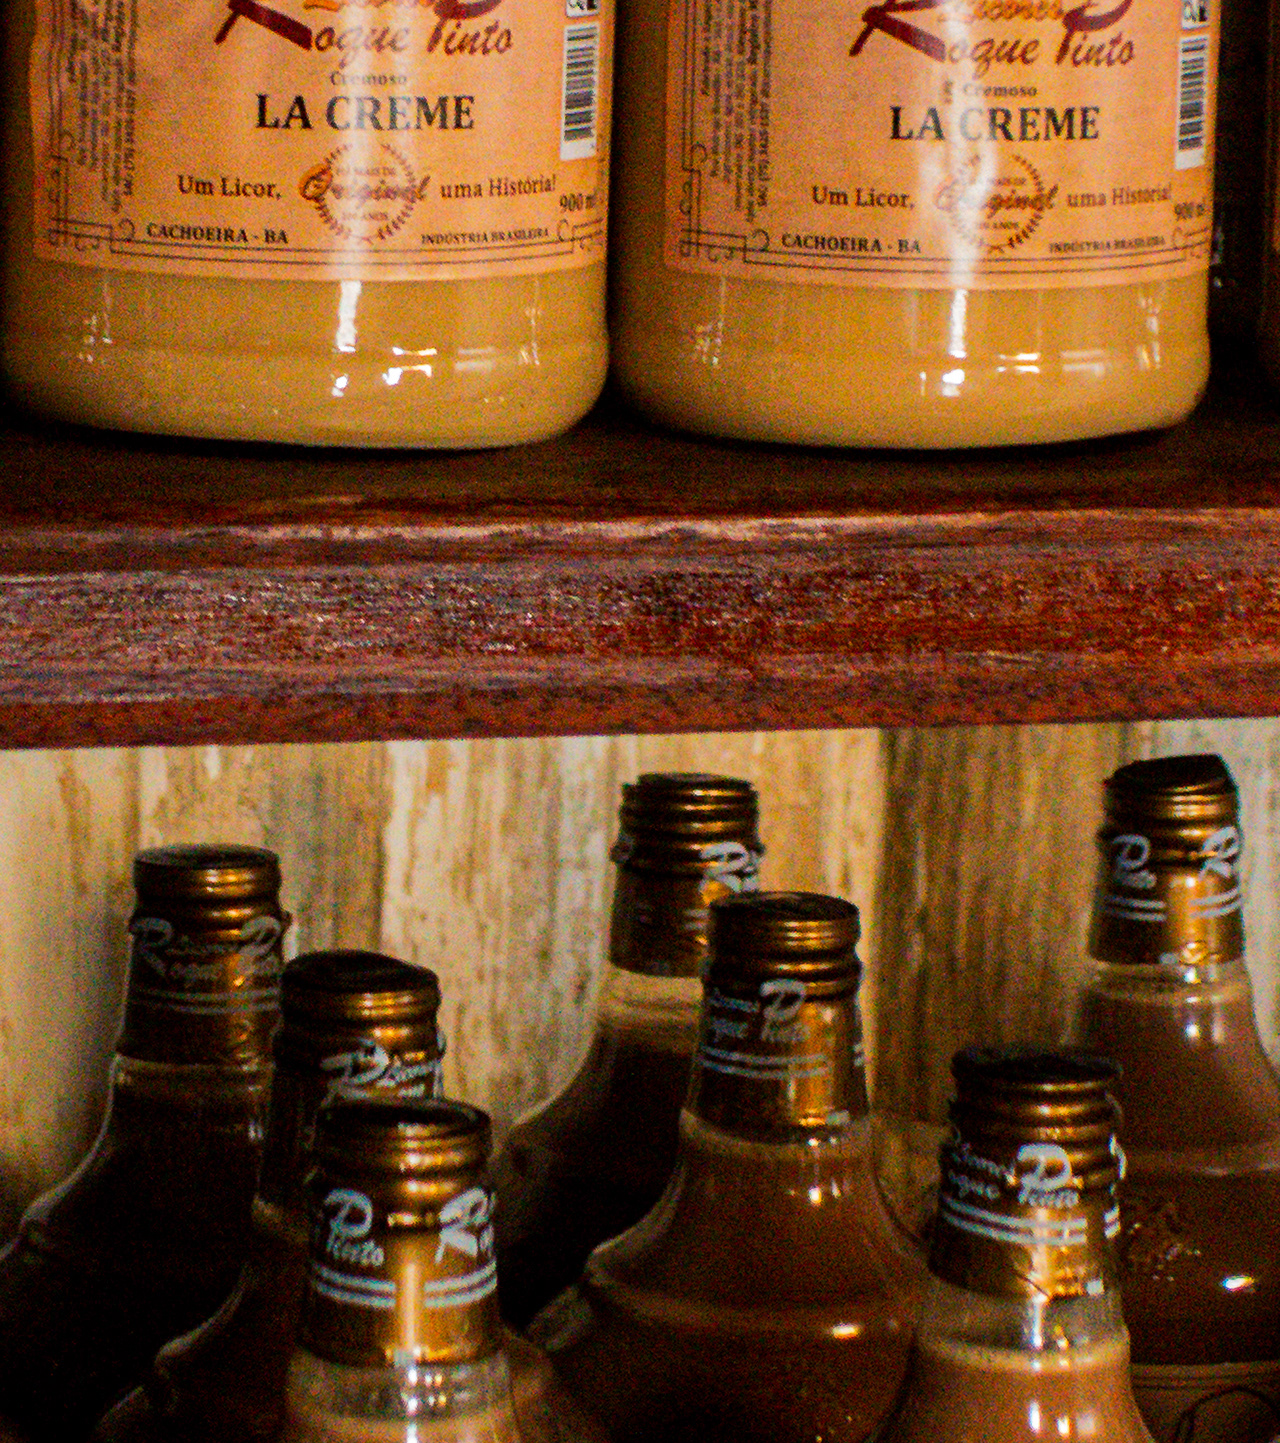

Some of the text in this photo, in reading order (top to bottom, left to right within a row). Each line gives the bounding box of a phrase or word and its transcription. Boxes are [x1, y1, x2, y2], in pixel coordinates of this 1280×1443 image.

[330, 71, 407, 85] Cremoso
[963, 83, 1037, 97] Cremoso
[255, 94, 475, 130] LA CREME
[889, 106, 1100, 141] LA CREME
[177, 174, 556, 200] Um Licor, uma História!
[812, 183, 1171, 209] Um Licor, uma História!
[146, 224, 288, 243] CACHOEIRA BA
[782, 235, 920, 252] CACHOEIRA BA
[325, 1190, 384, 1268] Pinto
